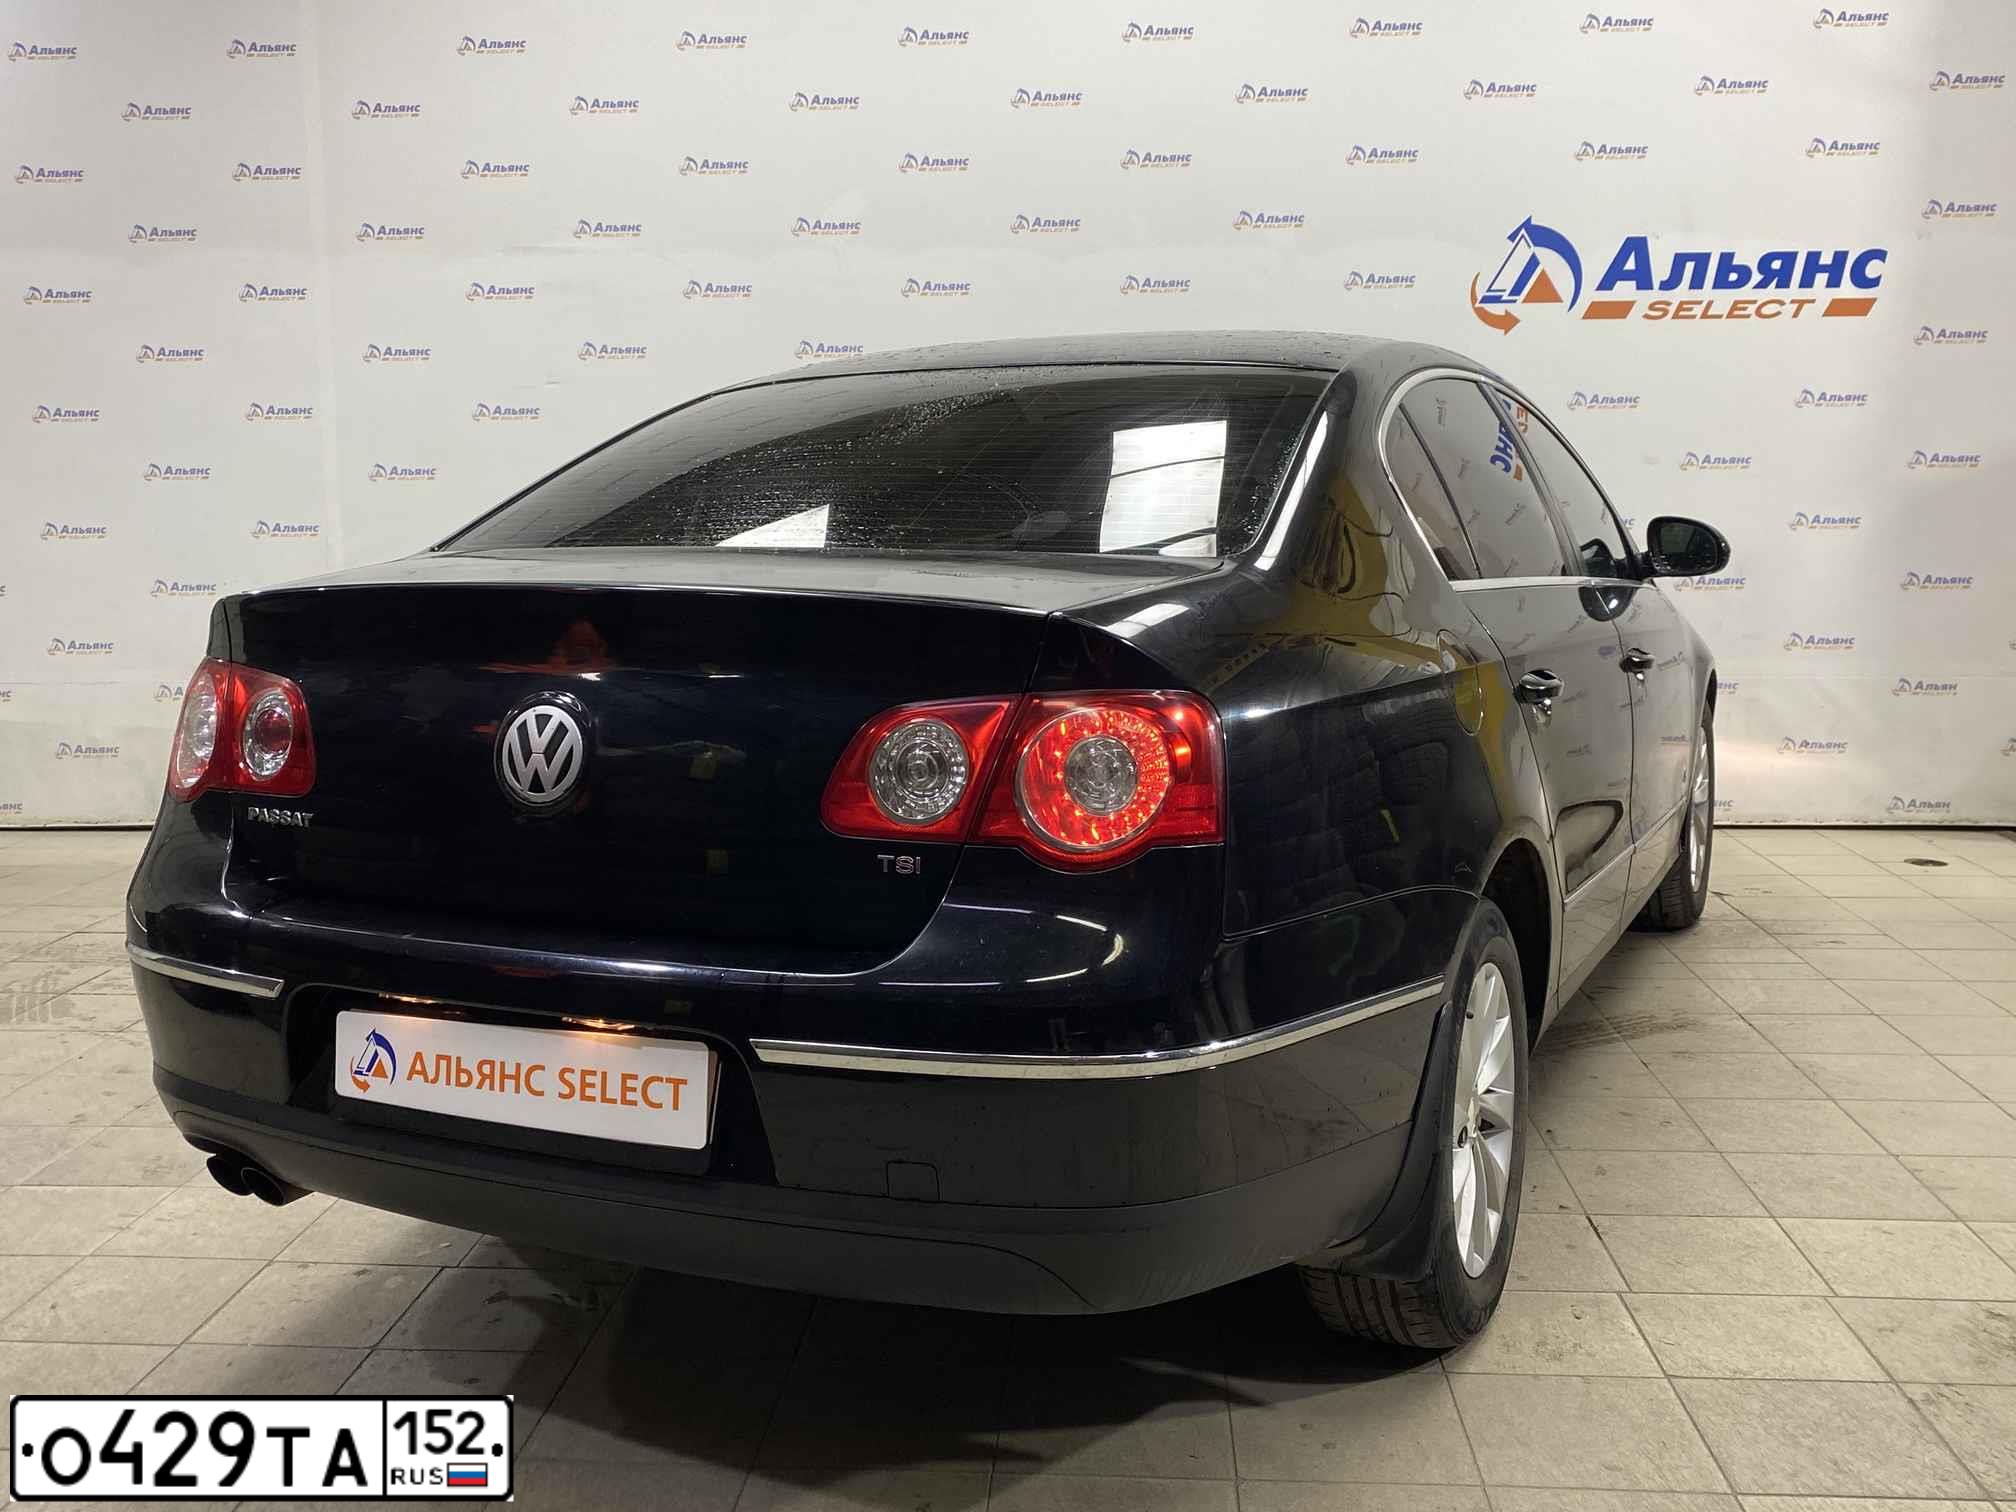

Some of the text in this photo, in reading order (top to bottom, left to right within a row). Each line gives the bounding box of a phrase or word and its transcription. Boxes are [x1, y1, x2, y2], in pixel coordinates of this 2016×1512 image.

[1602, 16, 1654, 27] Альянс
[1836, 11, 1889, 22] Альянс
[1144, 25, 1194, 36] Альянс
[1372, 20, 1423, 31] Альянс
[698, 33, 747, 44] Альянс
[920, 29, 969, 40] Альянс
[248, 42, 296, 52] Альянс
[478, 38, 526, 49] Альянс
[28, 45, 77, 55] Альянс
[1717, 78, 1768, 89] Альянс
[1953, 73, 2005, 84] Альянс
[1258, 86, 1308, 97] Альянс
[1486, 82, 1537, 93] Альянс
[810, 94, 860, 105] Альянс
[1032, 91, 1082, 101] Альянс
[372, 103, 420, 113] Альянс
[590, 98, 639, 108] Альянс
[143, 105, 191, 115] Альянс
[1597, 144, 1648, 154] Альянс
[1828, 140, 1880, 151] Альянс
[1142, 152, 1192, 163] Альянс
[1368, 148, 1419, 158] Альянс
[700, 159, 749, 169] Альянс
[920, 156, 969, 166] Альянс
[253, 165, 301, 175] Альянс
[481, 162, 529, 172] Альянс
[36, 168, 84, 178] Альянс
[1945, 202, 1997, 212] Альянс
[1032, 217, 1081, 227] Альянс
[1255, 213, 1305, 223] Альянс
[377, 225, 425, 235] Альянс
[594, 222, 642, 232] Альянс
[812, 220, 861, 230] Альянс
[149, 227, 197, 237] Альянс
[1595, 235, 1889, 292] Альянс
[1141, 278, 1191, 288] Альянс
[1365, 273, 1416, 284] Альянс
[259, 286, 307, 296] Альянс
[486, 285, 534, 295] Альянс
[704, 283, 752, 293] Альянс
[922, 281, 970, 291] Альянс
[44, 289, 92, 299] Альянс
[1641, 298, 1816, 320] SELECT
[1936, 328, 1988, 339] Альянс
[156, 347, 204, 357] Альянс
[383, 346, 430, 356] Альянс
[599, 344, 647, 355] Альянс
[816, 342, 864, 353] Альянс
[1589, 394, 1640, 404] Альянс
[1817, 392, 1868, 402] Альянс
[52, 408, 100, 418] Альянс
[265, 405, 313, 415] Альянс
[492, 405, 540, 416] Альянс
[1701, 454, 1752, 465] Альянс
[1930, 453, 1980, 463] Альянс
[163, 466, 211, 476] Альянс
[389, 466, 436, 476] Альянс
[1811, 514, 1861, 525] Альянс
[60, 525, 107, 535] Альянс
[272, 523, 319, 533] Альянс
[1922, 574, 1973, 585] Альянс
[170, 582, 217, 591] Альянс
[67, 640, 114, 650] Альянс
[1805, 635, 1855, 645] Альянс
[1914, 680, 1957, 691] Альян
[74, 744, 119, 754] Альянс
[1907, 799, 1951, 809] Альян
[247, 806, 314, 828] PASSAT
[876, 854, 920, 874] TSI
[406, 1051, 688, 1111] АЛЬЯНС SELECT
